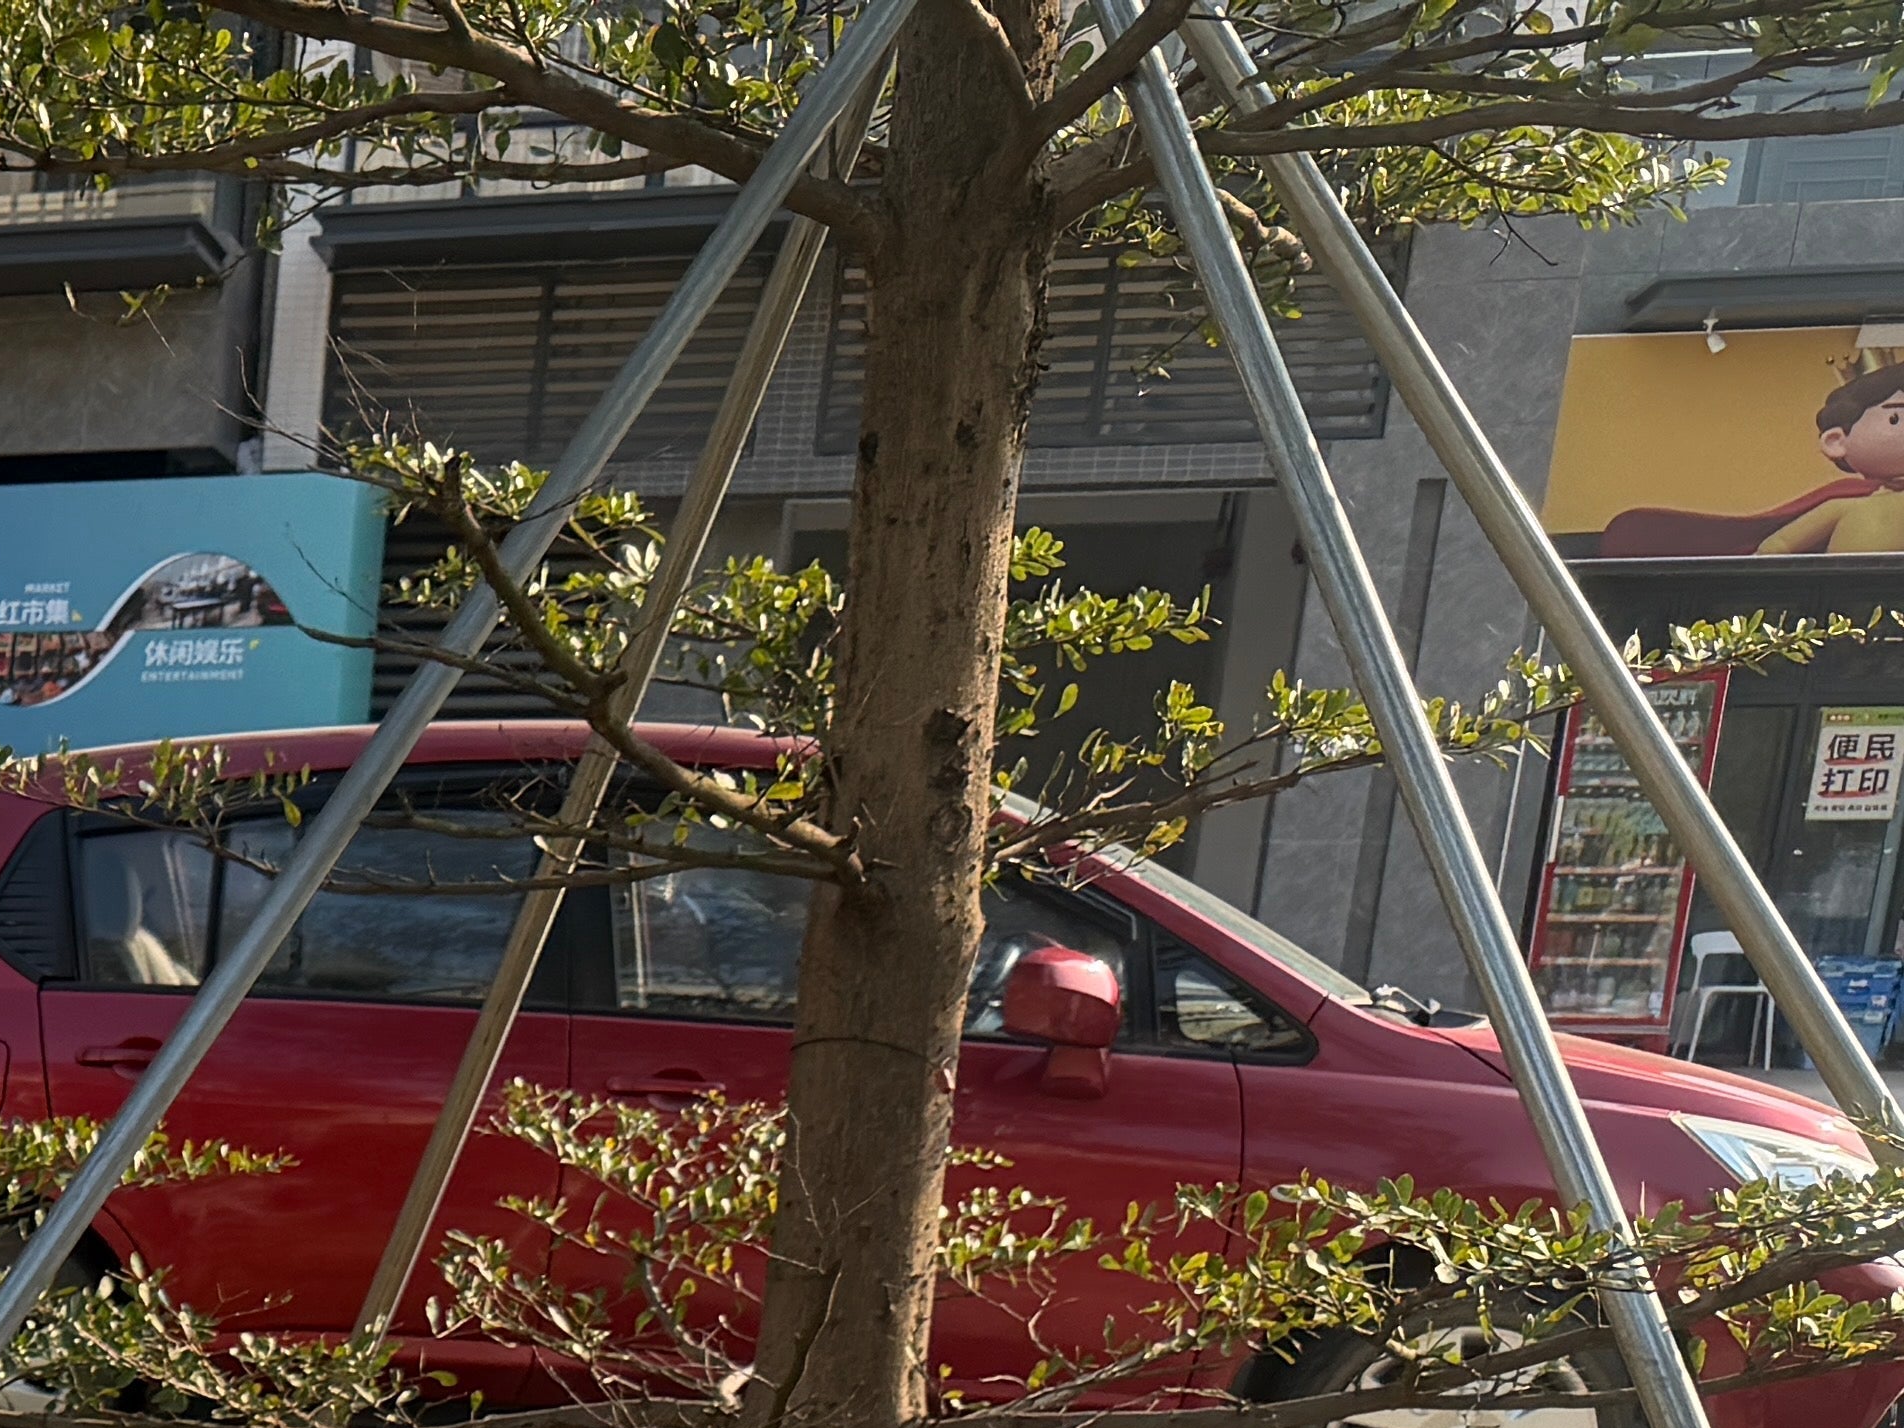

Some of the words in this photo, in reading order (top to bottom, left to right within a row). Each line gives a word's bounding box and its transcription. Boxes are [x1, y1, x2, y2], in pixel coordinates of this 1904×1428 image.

[144, 638, 244, 667] 休闲娱乐
[1828, 734, 1895, 760] 便民
[1821, 768, 1889, 795] 打印
